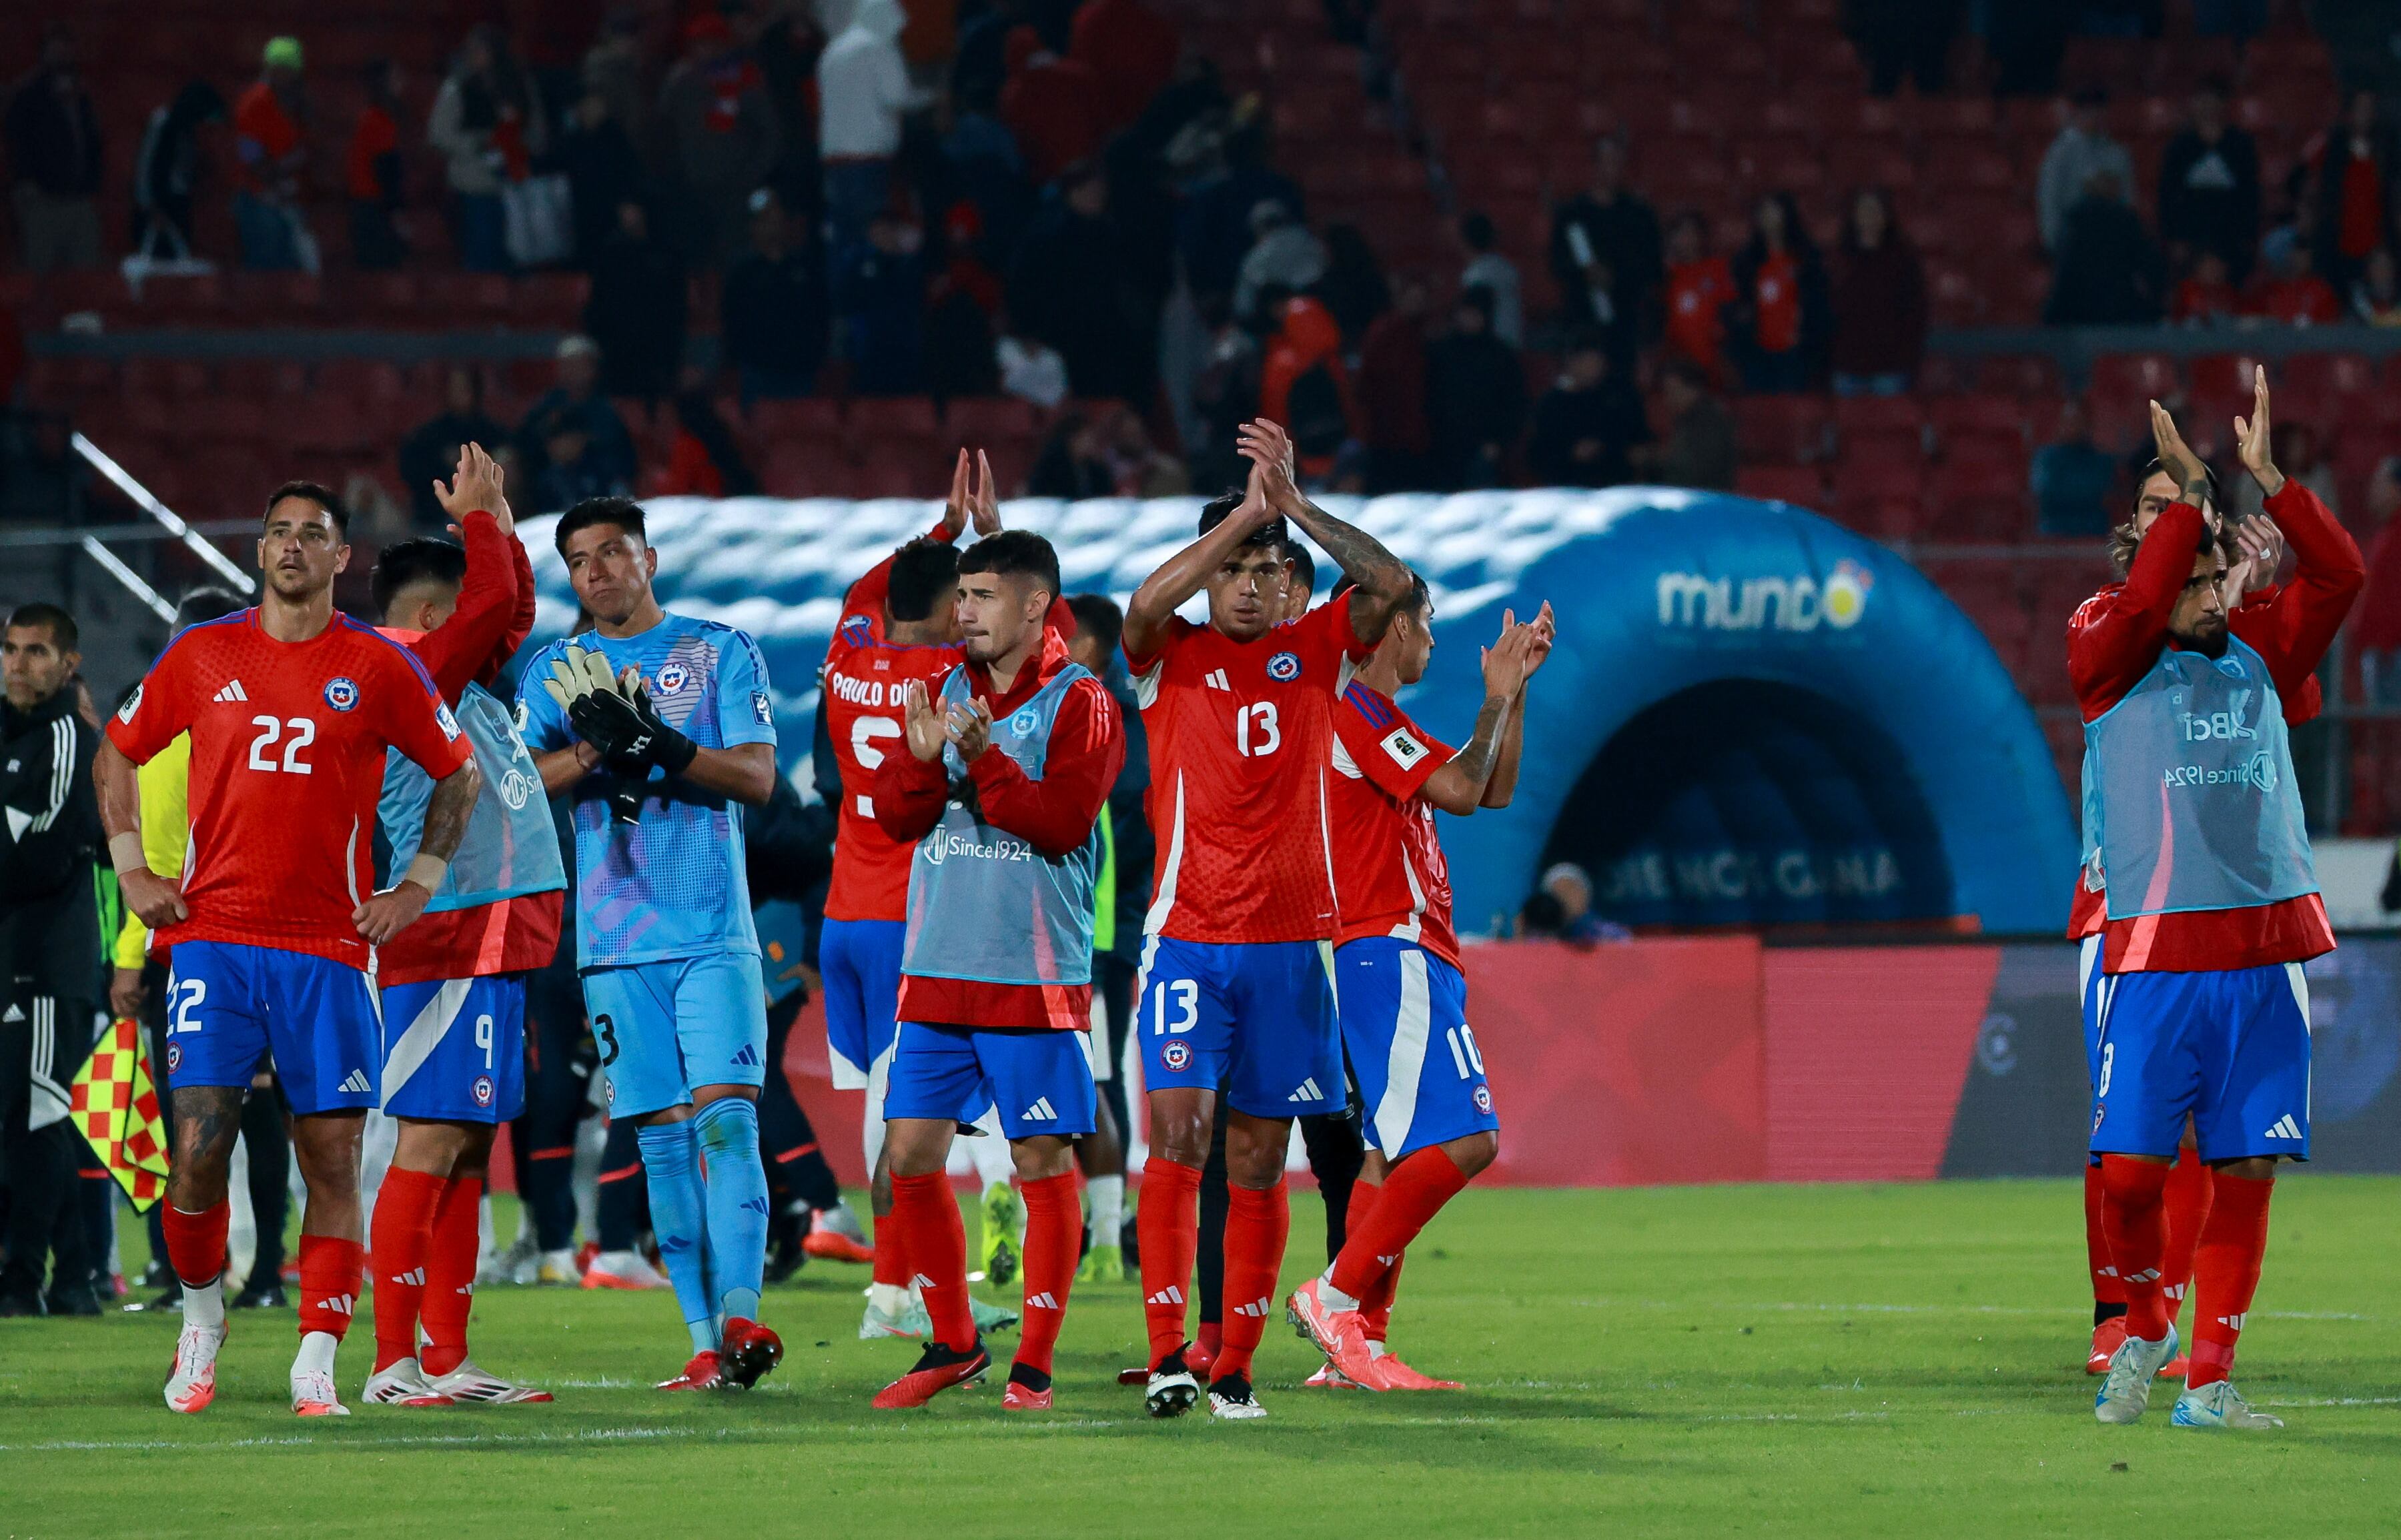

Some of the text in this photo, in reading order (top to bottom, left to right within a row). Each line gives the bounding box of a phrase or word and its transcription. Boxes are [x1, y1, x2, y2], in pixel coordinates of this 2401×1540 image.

[833, 672, 883, 707] PAULO
[249, 715, 315, 774] 22
[1238, 701, 1280, 756] 13
[501, 770, 527, 809] MG
[1155, 979, 1198, 1035] 13
[476, 1014, 493, 1069] 9
[1446, 1024, 1484, 1080] 10
[2099, 1042, 2114, 1098] 8
